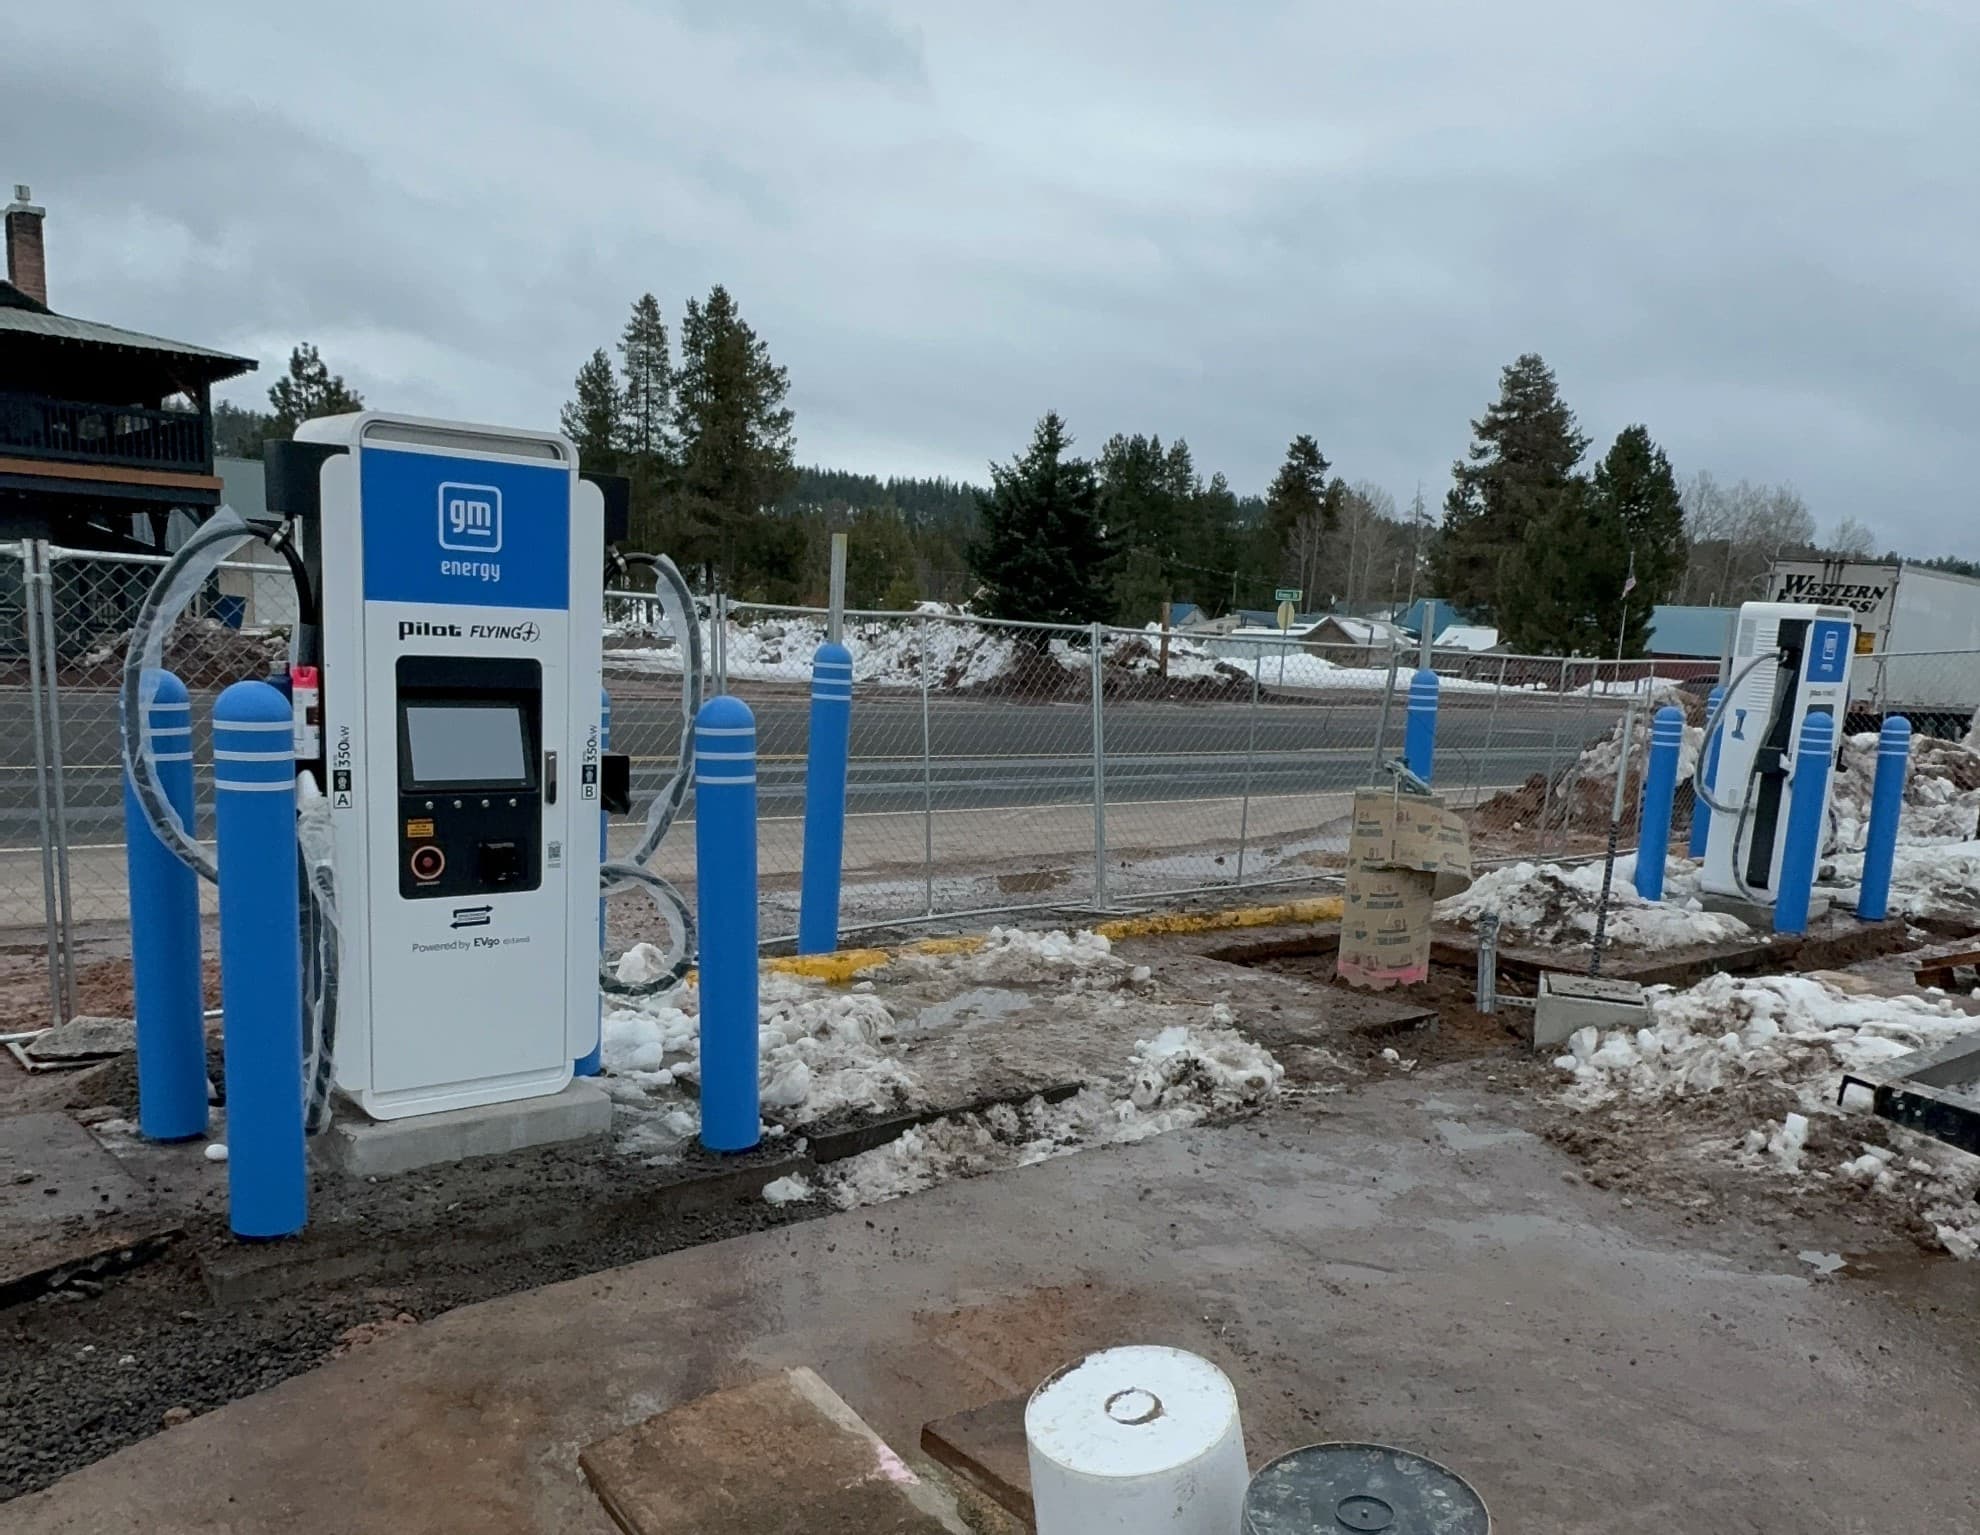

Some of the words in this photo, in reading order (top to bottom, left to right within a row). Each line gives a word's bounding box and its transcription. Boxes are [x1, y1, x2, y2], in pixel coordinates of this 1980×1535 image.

[450, 499, 491, 536] gm
[441, 560, 500, 582] energy
[1785, 574, 1888, 600] WESTERN
[337, 793, 349, 806] A
[585, 785, 594, 798] B
[411, 941, 457, 953] Powered
[458, 941, 471, 952] by
[474, 937, 500, 949] EVgo
